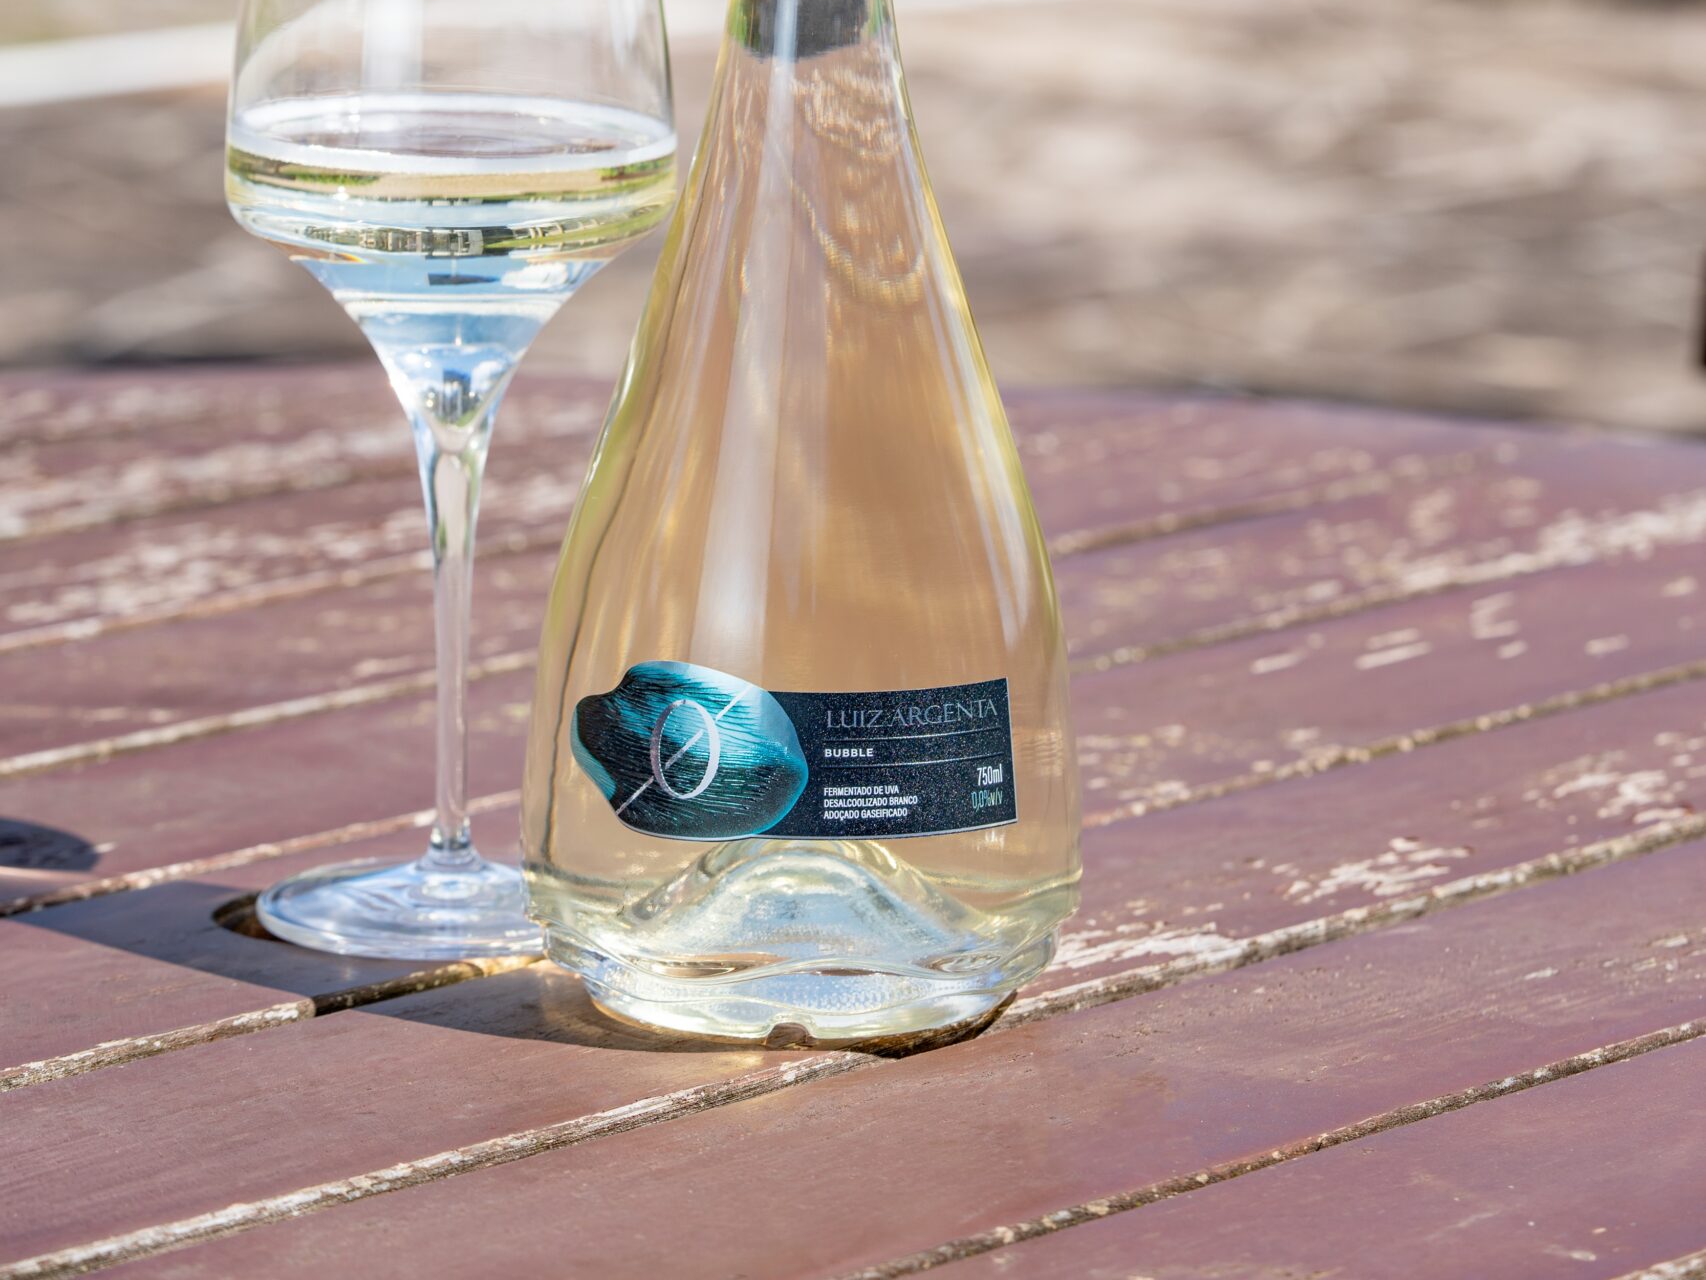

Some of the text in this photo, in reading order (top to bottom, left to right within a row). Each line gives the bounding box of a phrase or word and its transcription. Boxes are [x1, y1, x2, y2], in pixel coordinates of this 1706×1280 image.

[826, 699, 998, 729] LUIZ ARGENTA
[824, 747, 874, 758] BUBBLE
[976, 763, 1004, 786] 750ml
[823, 785, 900, 797] FERMENTADO DE UVA
[823, 795, 919, 808] DESALCOOLIZADO BRANCO
[824, 808, 908, 820] ADOÇADO GASEIFICADO
